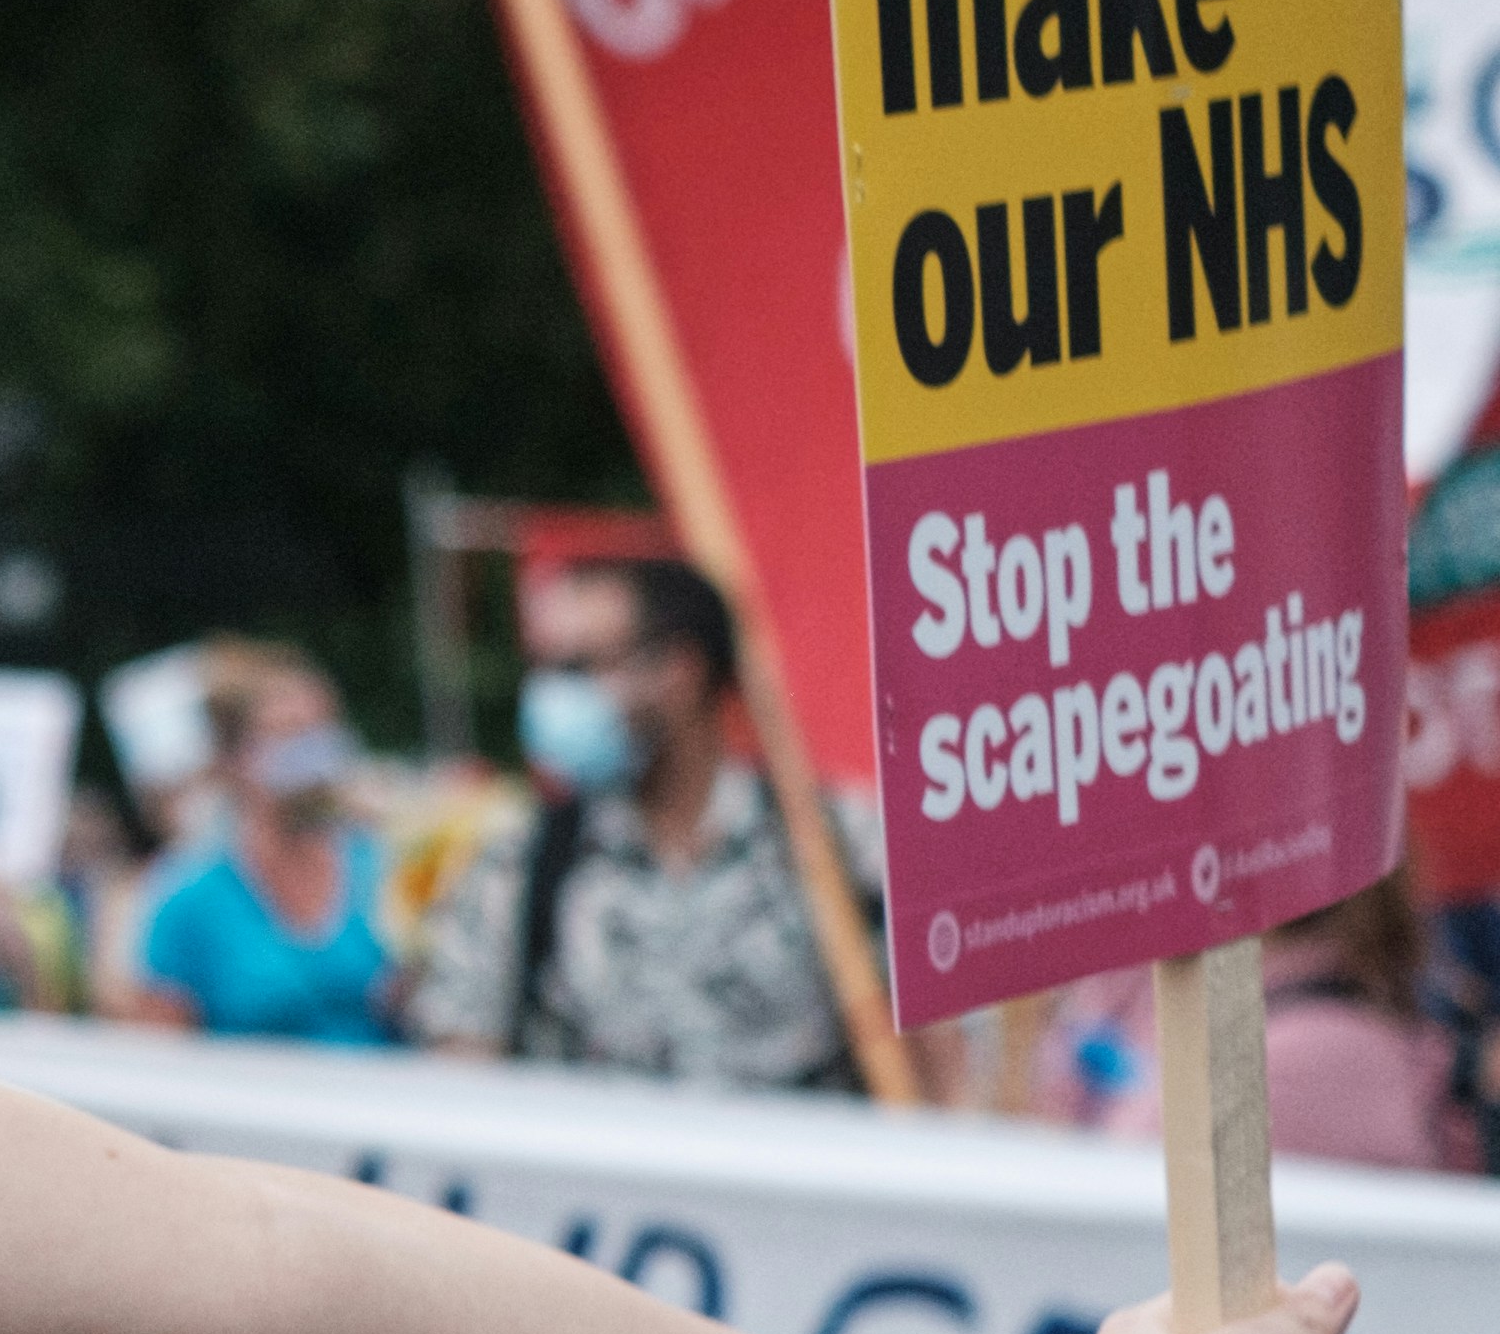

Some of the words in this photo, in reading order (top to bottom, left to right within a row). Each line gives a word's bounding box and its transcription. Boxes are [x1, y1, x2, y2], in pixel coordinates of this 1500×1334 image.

[891, 179, 1125, 389] our
[1158, 72, 1363, 345] NHS
[907, 510, 1094, 669] Stop
[1110, 469, 1236, 617] the
[918, 591, 1365, 827] scapegoating
